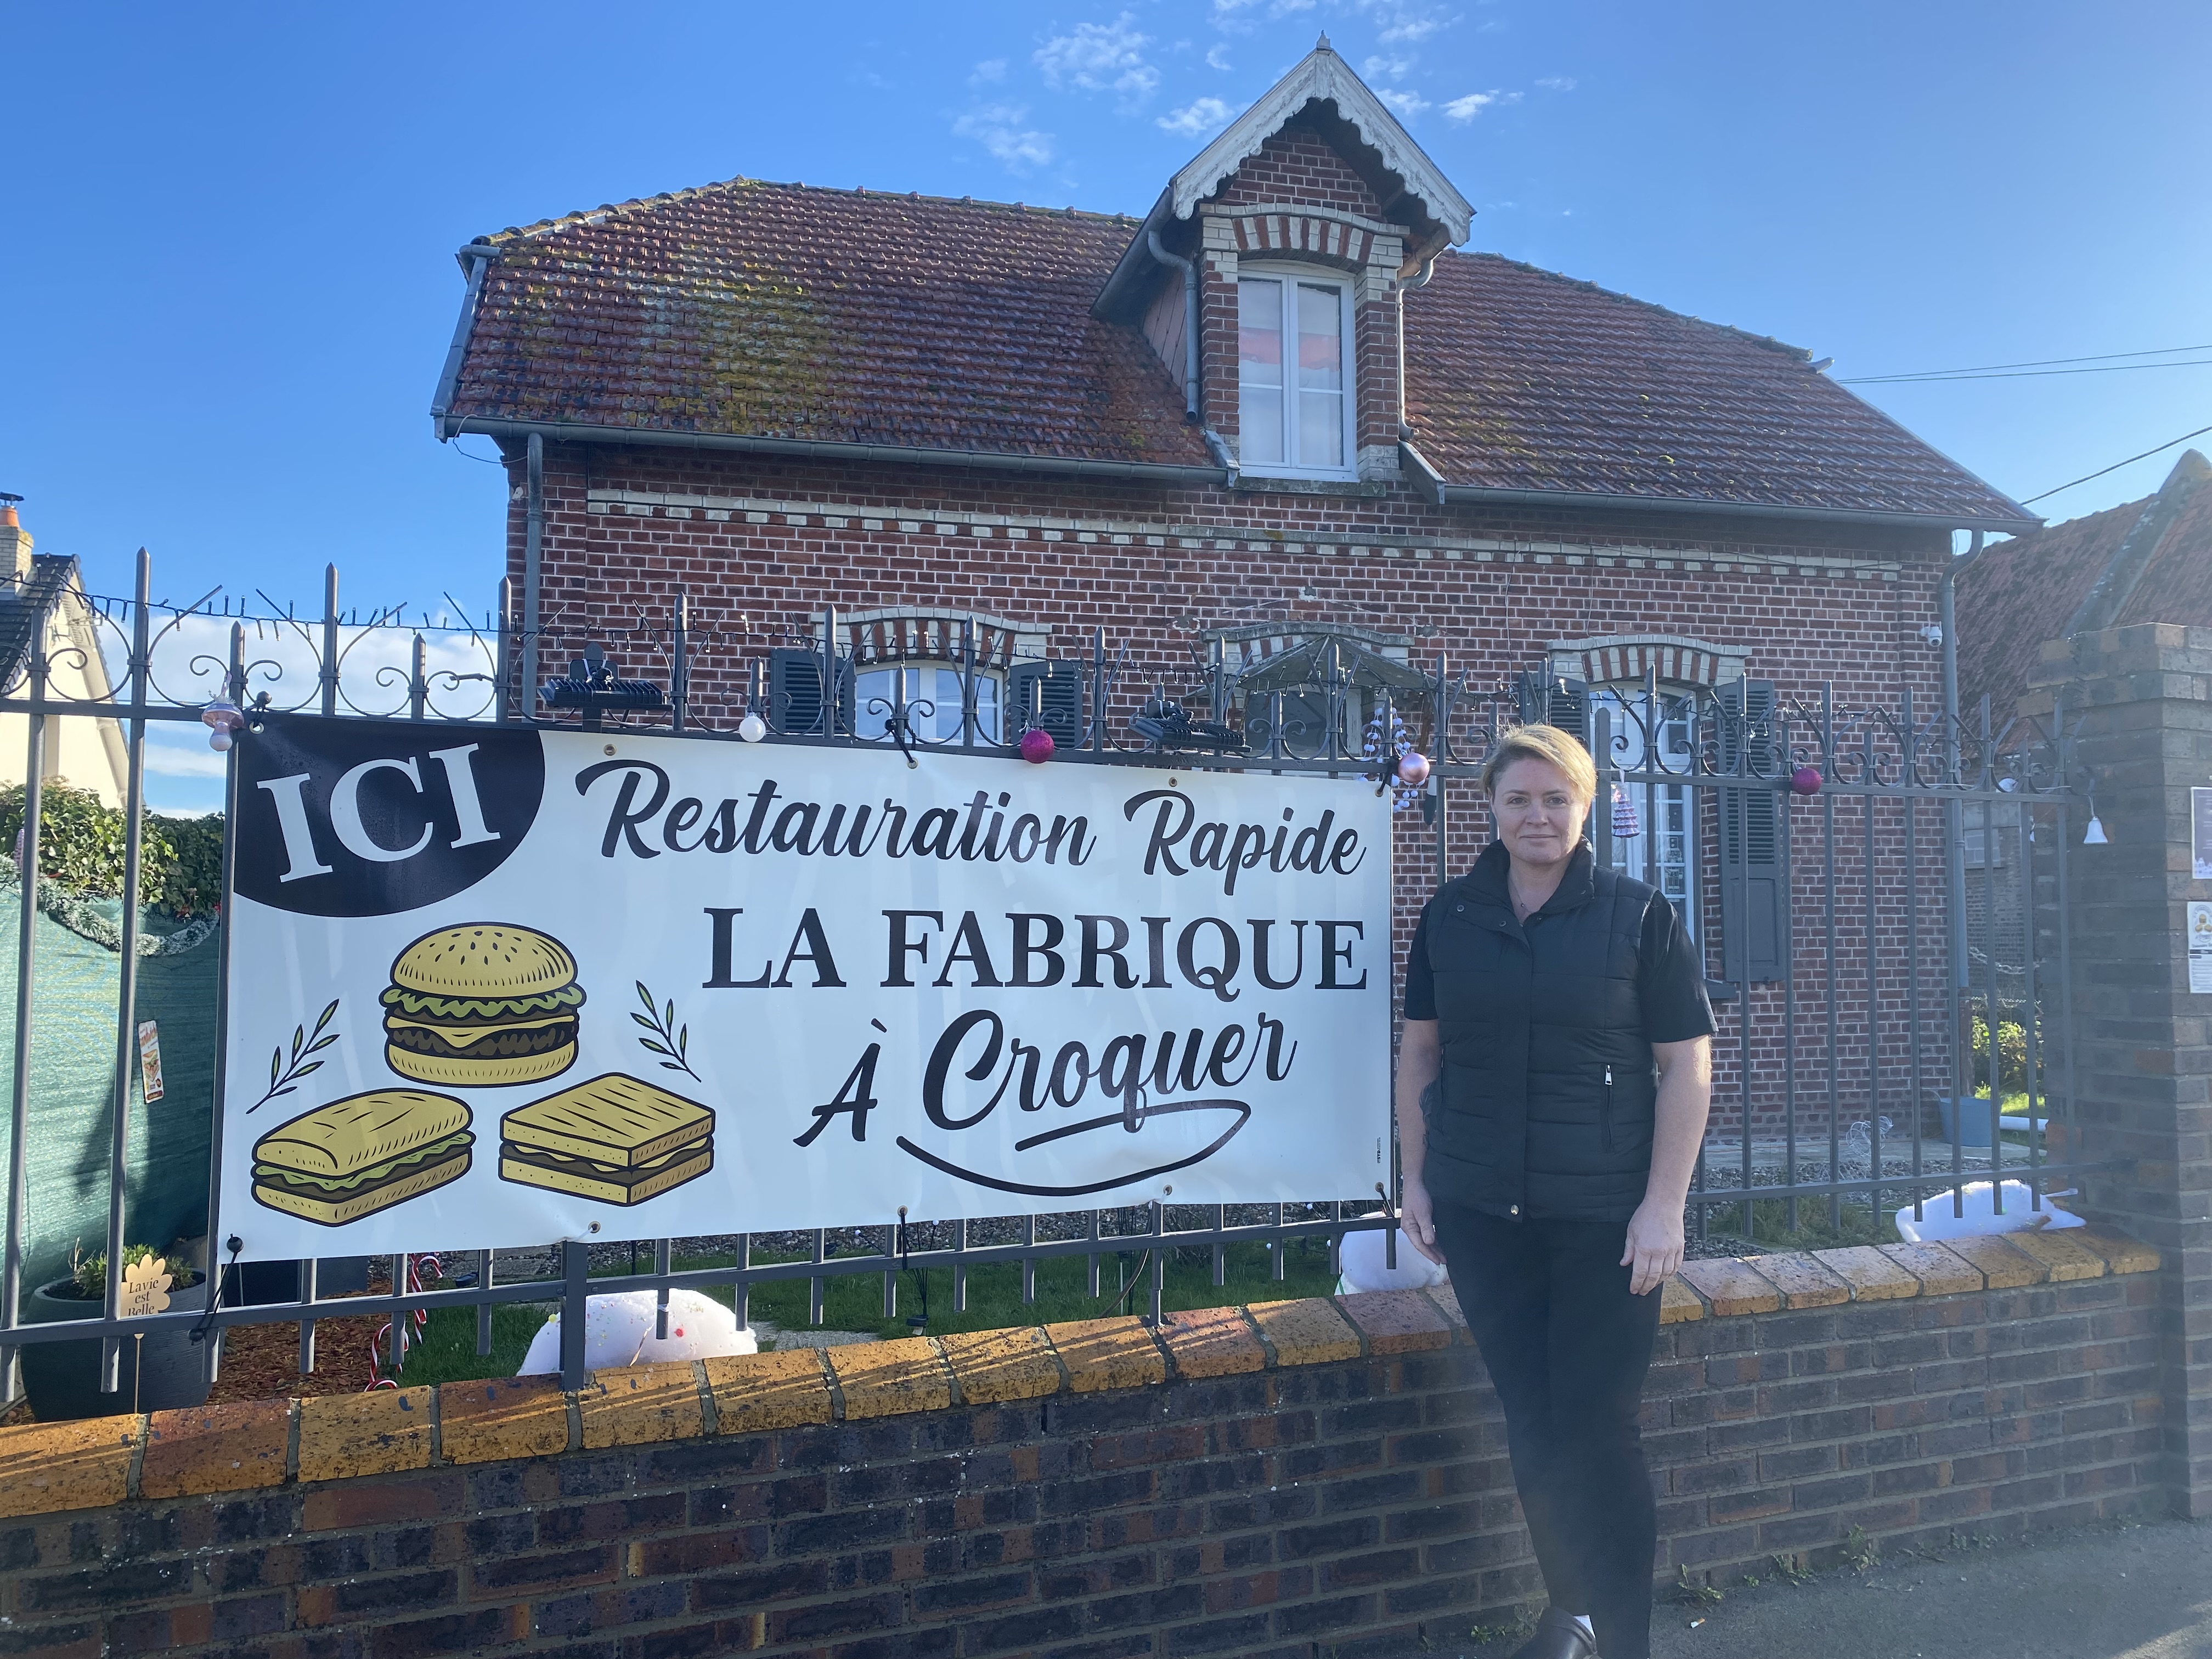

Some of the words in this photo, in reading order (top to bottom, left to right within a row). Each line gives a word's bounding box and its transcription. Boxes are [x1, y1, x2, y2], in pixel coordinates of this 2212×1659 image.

[256, 742, 501, 883] ICI
[575, 759, 1097, 866] Restauration
[1124, 789, 1367, 896] Rapide
[702, 907, 847, 989] LA
[880, 910, 1368, 1002] FABRIQUE
[793, 1018, 887, 1147] À
[923, 1009, 1297, 1133] Croquer
[135, 1291, 150, 1304] est
